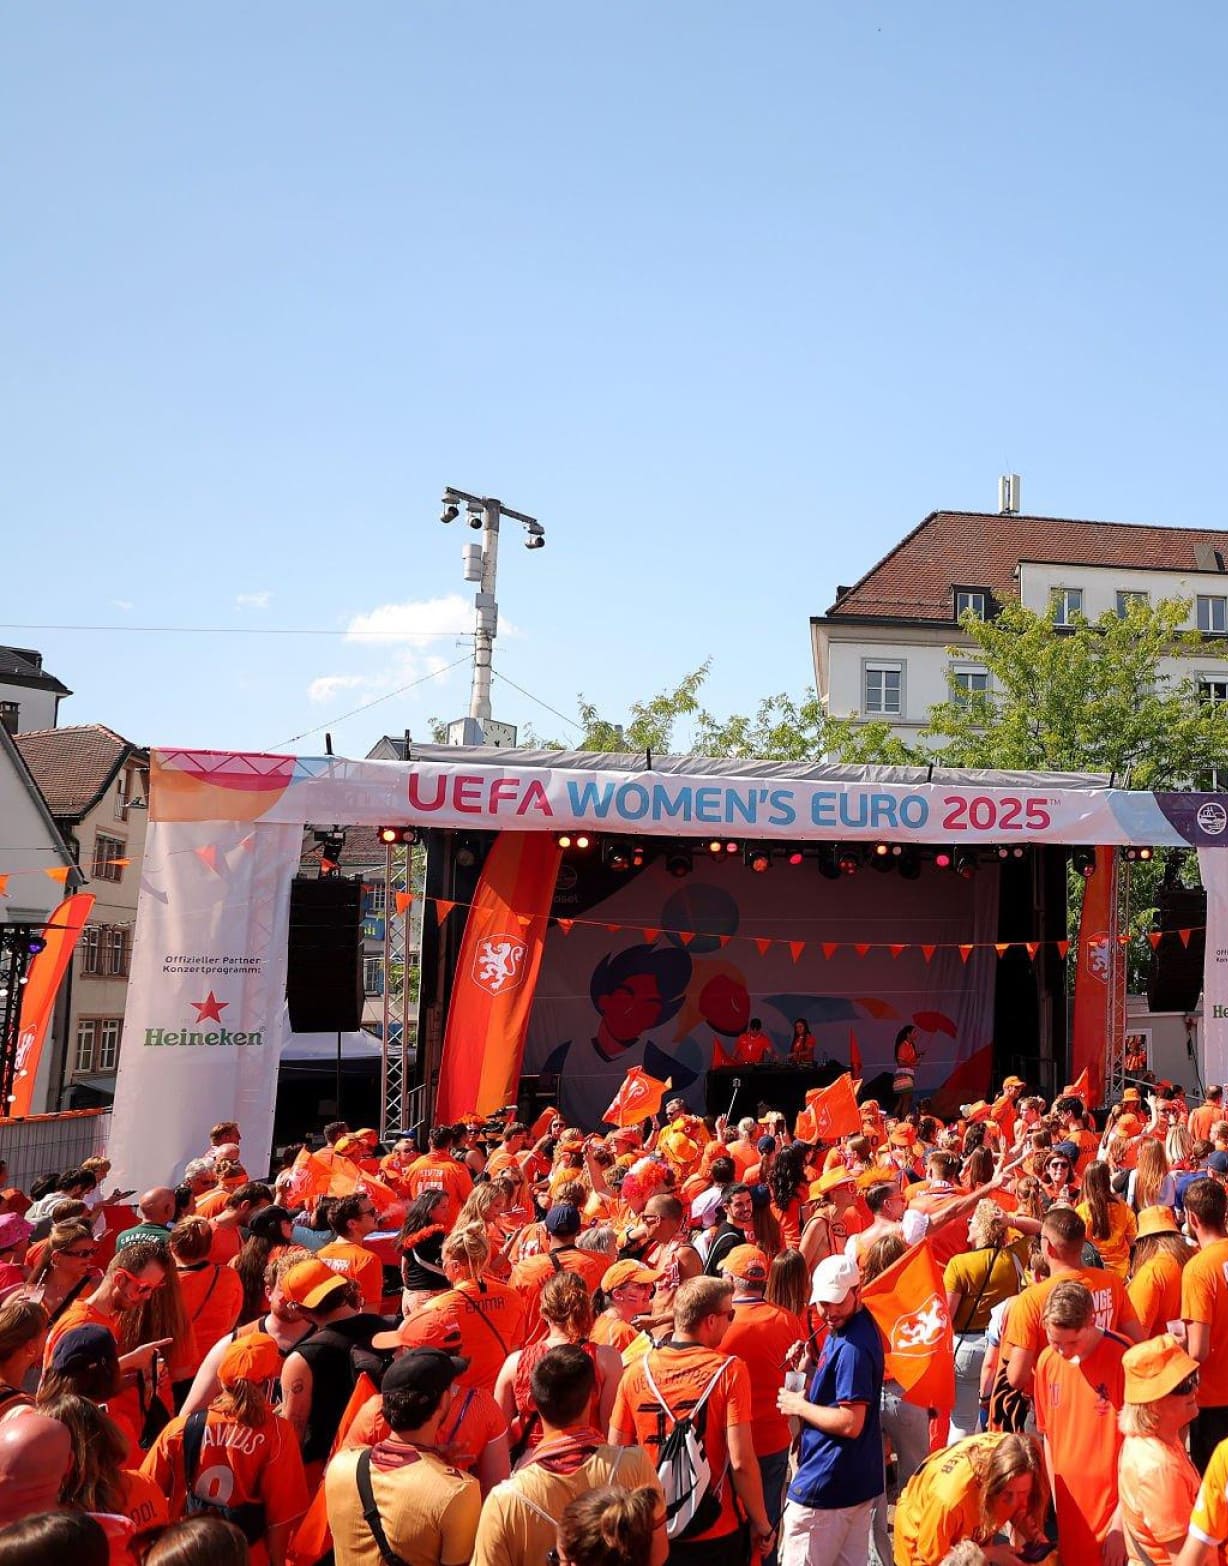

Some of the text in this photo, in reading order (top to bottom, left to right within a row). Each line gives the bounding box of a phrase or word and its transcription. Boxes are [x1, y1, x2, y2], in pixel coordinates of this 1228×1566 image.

[408, 773, 553, 817] UEFA
[567, 781, 797, 826] WOMEN'S
[811, 791, 929, 829] EURO
[942, 796, 1050, 830] 2025
[165, 956, 260, 965] Offizieller Partner
[162, 965, 261, 975] Konzertprogramm:
[143, 1028, 264, 1046] Heineken
